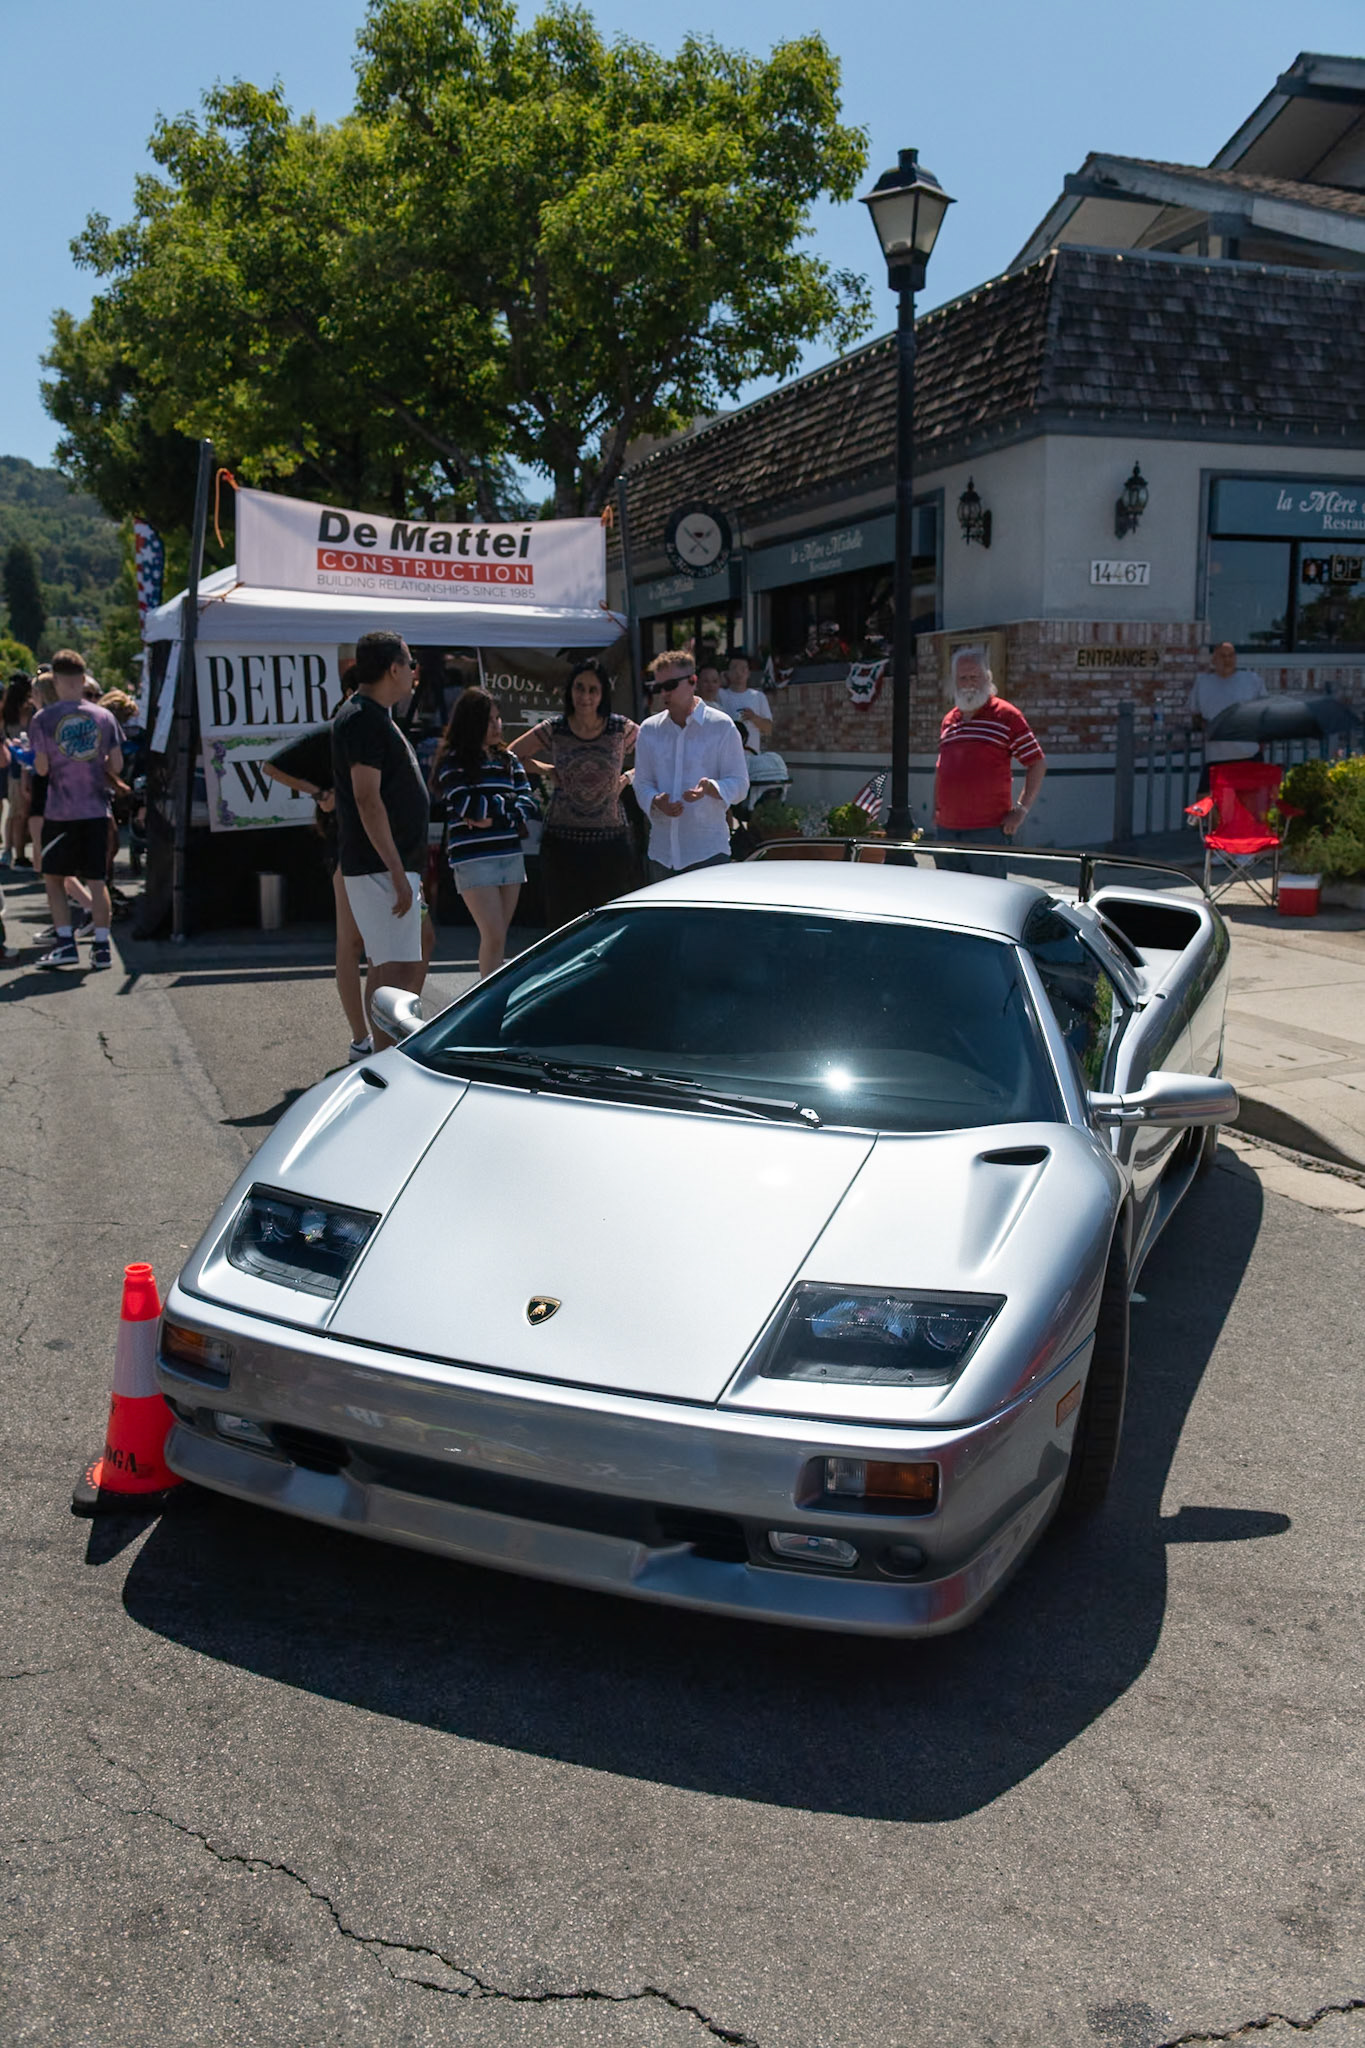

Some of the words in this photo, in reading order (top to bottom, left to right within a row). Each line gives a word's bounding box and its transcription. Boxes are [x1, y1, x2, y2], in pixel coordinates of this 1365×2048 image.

[1276, 489, 1293, 511] la
[318, 510, 378, 548] De
[390, 522, 533, 559] Mattei
[322, 551, 529, 582] CONSTRUCTION
[317, 574, 376, 590] BUILDING
[379, 578, 470, 596] RELATIONSHIPS
[473, 586, 507, 598] SINCE
[510, 588, 536, 599] 1985
[1077, 648, 1146, 668] ENTRANCE
[205, 654, 334, 727] BEER
